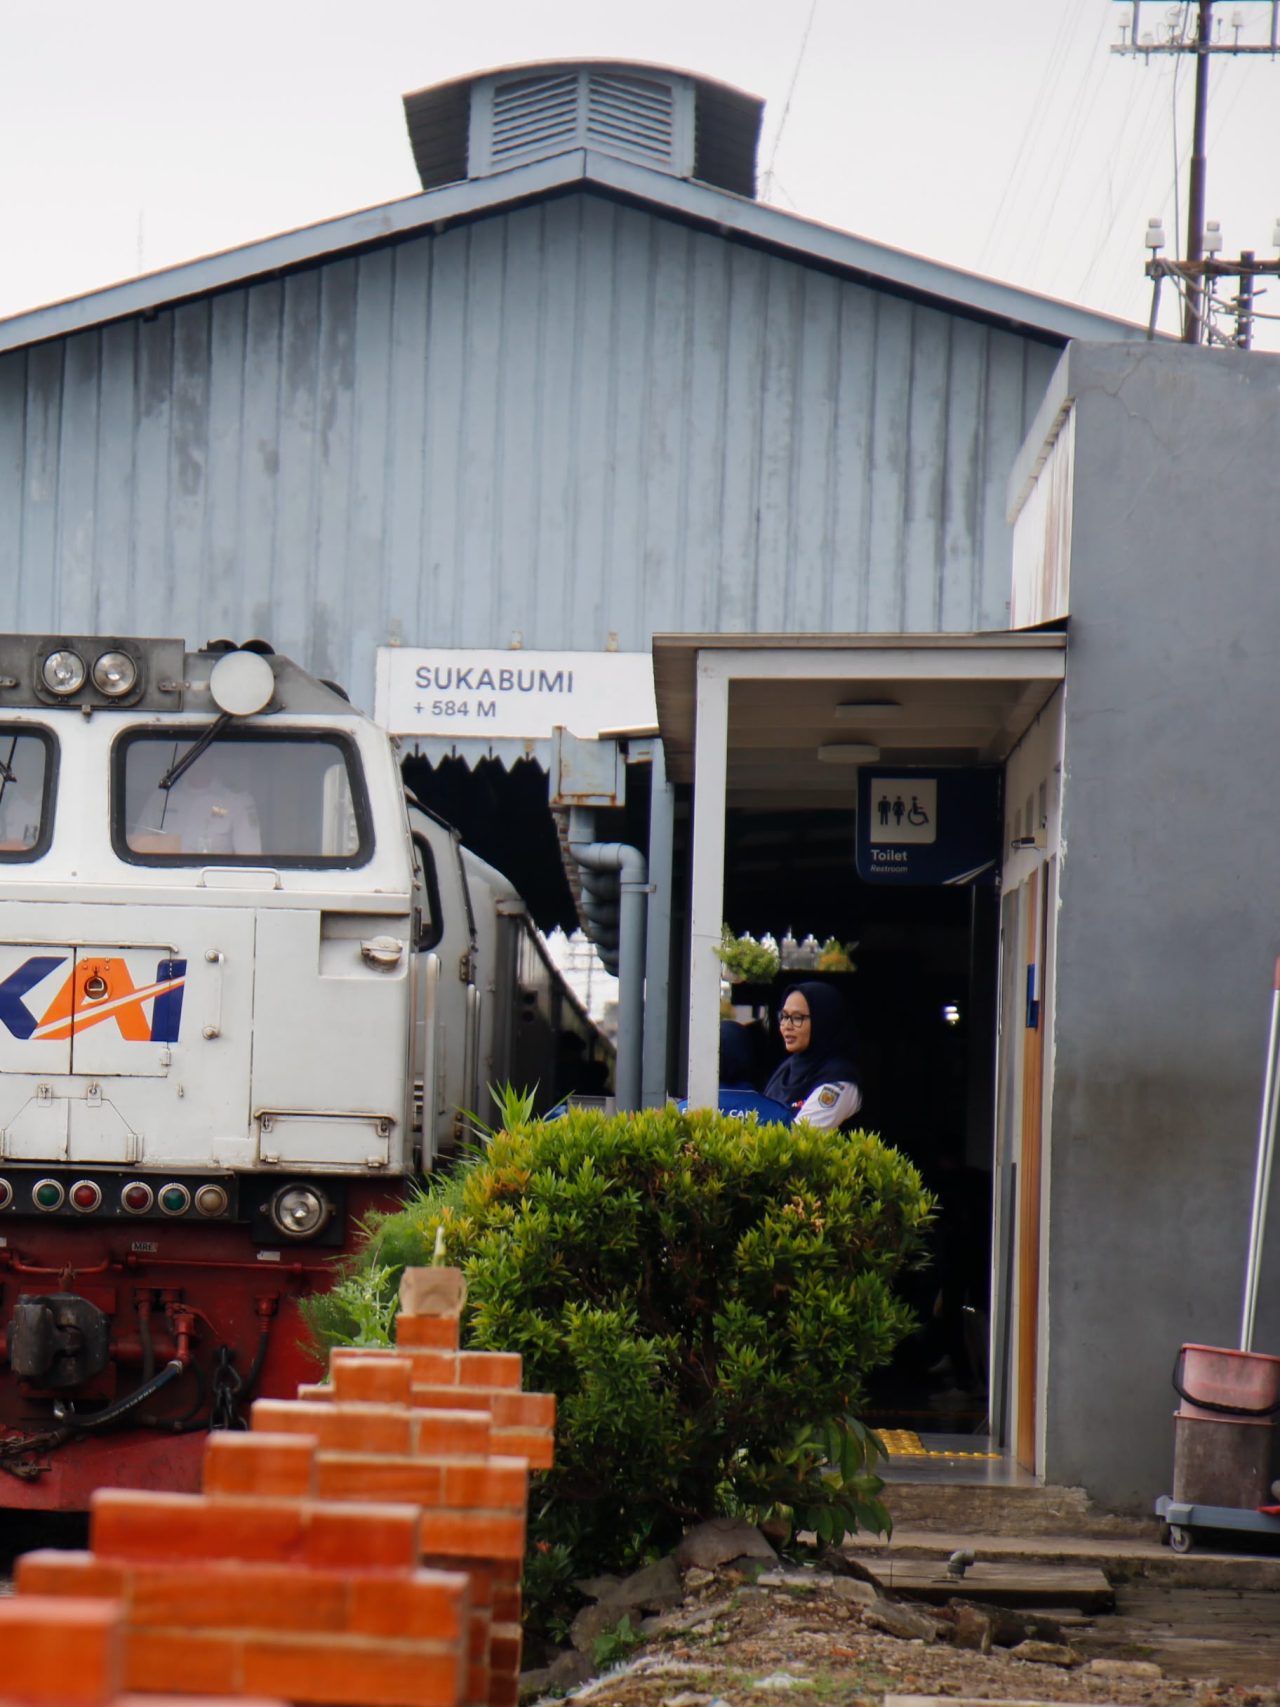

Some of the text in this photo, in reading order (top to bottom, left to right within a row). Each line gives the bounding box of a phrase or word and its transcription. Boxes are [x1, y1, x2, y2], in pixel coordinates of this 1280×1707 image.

[415, 665, 573, 693] SUKABUMI
[431, 700, 469, 717] 584
[477, 700, 496, 717] M
[870, 849, 908, 861] Toilet
[870, 864, 909, 873] Restroom
